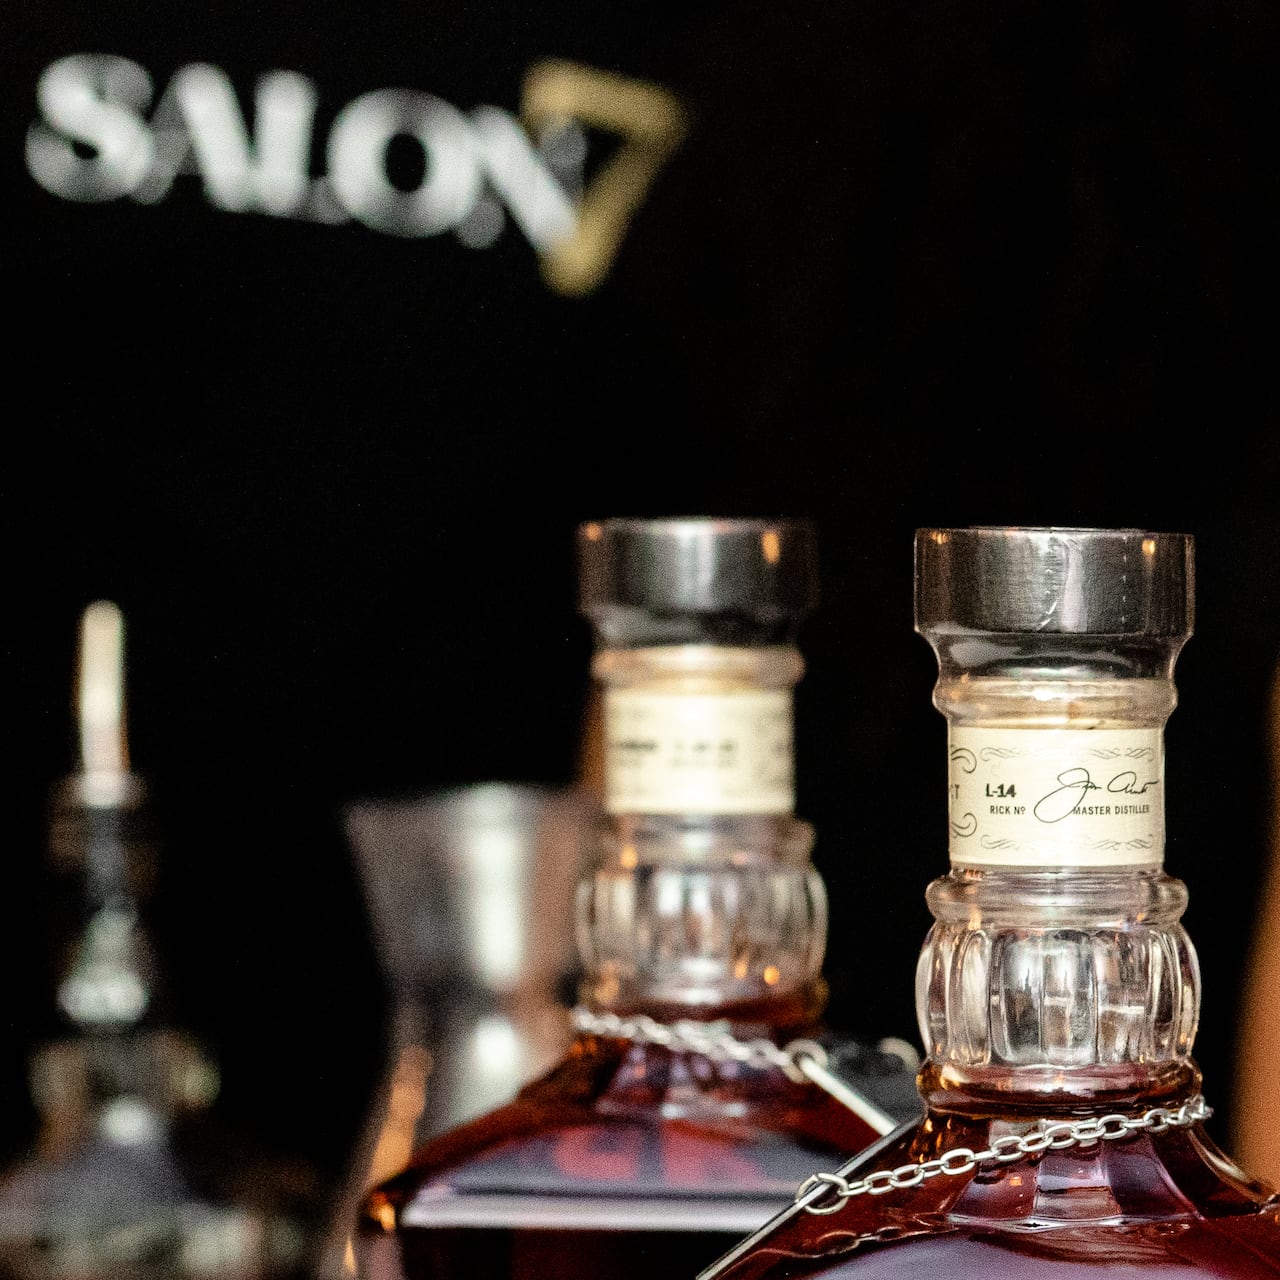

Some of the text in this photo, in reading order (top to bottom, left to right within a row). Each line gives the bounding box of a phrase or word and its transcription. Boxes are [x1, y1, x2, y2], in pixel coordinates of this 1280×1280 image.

[985, 783, 1017, 798] L-14
[989, 804, 1010, 815] RICK
[1073, 804, 1150, 816] MASTER DISTILLER
